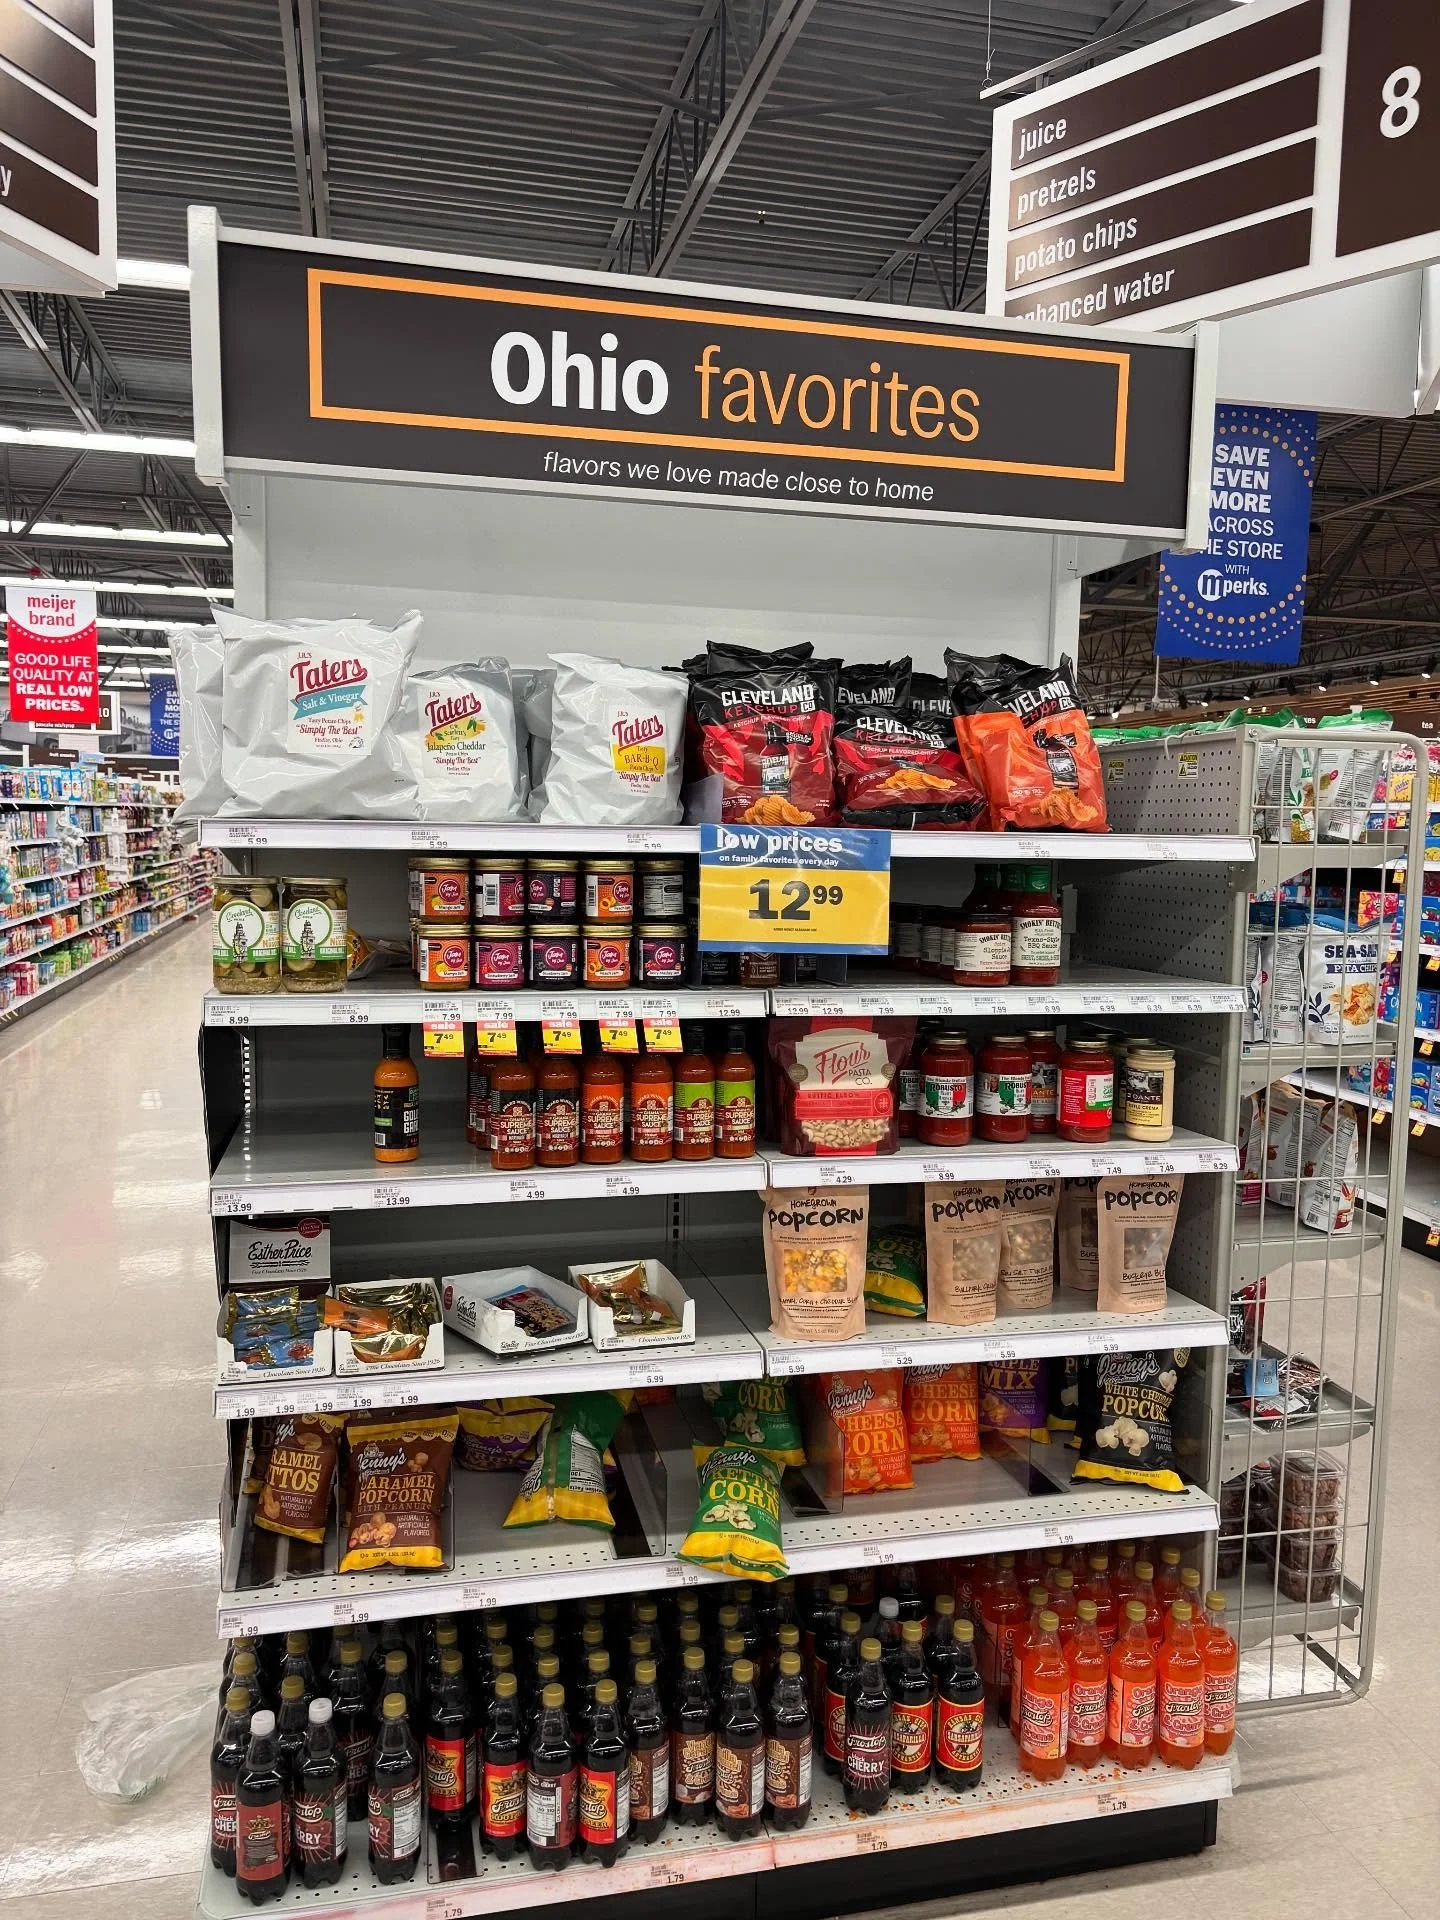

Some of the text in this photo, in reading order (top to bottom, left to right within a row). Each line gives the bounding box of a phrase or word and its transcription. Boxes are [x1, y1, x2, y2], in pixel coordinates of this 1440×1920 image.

[1379, 65, 1421, 139] 8
[1019, 118, 1067, 160] juice
[1017, 167, 1096, 220] pretzels
[1014, 217, 1138, 281] potato chips
[1113, 268, 1175, 306] water
[491, 331, 980, 442] Ohio favorites
[1214, 444, 1270, 467] SAVE
[543, 452, 934, 500] flavors we love made close to home
[1212, 467, 1269, 490] EVEN
[1209, 490, 1271, 513] MORE
[1200, 539, 1284, 560] HE STORE
[1225, 564, 1250, 575] WITH
[27, 595, 76, 612] meijer
[29, 611, 75, 627] brand
[15, 653, 92, 668] GOOD LIFE
[13, 668, 95, 683] QUALITY AT
[290, 658, 368, 694] Taters
[16, 684, 93, 697] REAL LOW
[721, 684, 814, 706] CLEVELAND
[25, 699, 85, 712] PRICES.
[302, 692, 360, 711] Salt & Vinegar
[425, 692, 482, 727] Taters
[724, 703, 798, 719] KETCHUP
[856, 716, 942, 741] CLEVELAND
[1421, 721, 1434, 729] tea
[327, 726, 341, 735] The
[612, 715, 663, 747] Taters
[457, 741, 486, 751] Cheddar
[640, 773, 650, 782] The
[248, 837, 268, 845] 5.99
[429, 840, 448, 849] 5.99
[716, 829, 843, 854] low prices
[732, 854, 758, 863] family
[759, 855, 798, 864] favorites
[799, 858, 823, 866] every
[824, 858, 839, 867] day
[559, 1011, 577, 1019] 7.99
[615, 1010, 633, 1018] 7.99
[659, 1010, 677, 1018] 7.99
[718, 1008, 741, 1017] 12.99
[822, 1007, 844, 1015] 12.99
[937, 1006, 953, 1014] 7.99
[229, 1016, 249, 1024] 8.99
[350, 1015, 369, 1023] 8.99
[442, 1013, 461, 1021] 7.99
[494, 1012, 513, 1020] 7.99
[430, 1022, 456, 1031] sale
[483, 1021, 508, 1030] sale
[549, 1020, 573, 1029] sale
[606, 1019, 629, 1027] sale
[649, 1018, 673, 1027] sale
[813, 1041, 871, 1085] Flour
[848, 1069, 872, 1077] PASTA
[855, 1077, 873, 1085] CO.
[929, 1083, 963, 1092] ROBUSTO
[587, 1115, 619, 1123] SUPREME
[636, 1113, 667, 1122] SUPREME
[725, 1111, 754, 1119] SUPREME
[500, 1119, 532, 1128] SUPREME
[544, 1119, 576, 1127] SUPREME
[1106, 1167, 1122, 1175] 7.49
[1159, 1165, 1175, 1173] 7.49
[1213, 1162, 1228, 1170] 8.29
[526, 1190, 545, 1199] 4.99
[622, 1186, 640, 1195] 4.99
[386, 1196, 410, 1206] 13.99
[790, 1199, 837, 1210] HOMEGROWN
[226, 1203, 252, 1213] 13.99
[932, 1195, 1000, 1222] POPCORN
[768, 1207, 864, 1232] POPCORN
[248, 1238, 312, 1261] Esther Price
[380, 1361, 411, 1370] Chocolates
[427, 1358, 441, 1366] 1926
[789, 1365, 805, 1373] 5.99
[263, 1369, 295, 1378] Chocolates
[310, 1366, 326, 1374] 1926
[1097, 1351, 1160, 1388] Jenny's
[980, 1367, 1037, 1390] MIX
[911, 1383, 977, 1399] CHEESE
[1104, 1381, 1141, 1397] WHITE
[400, 1396, 419, 1404] 1.99
[738, 1381, 786, 1413] CORN
[827, 1379, 876, 1411] Jenny's
[314, 1402, 333, 1412] 1.99
[353, 1399, 372, 1408] 1.99
[236, 1408, 255, 1417] 1.99
[276, 1405, 295, 1414] 1.99
[911, 1400, 977, 1422] CORN
[836, 1410, 903, 1431] CHEESE
[845, 1427, 905, 1456] CORN
[357, 1447, 408, 1472] Jenny's
[701, 1450, 758, 1485] Jenny's
[711, 1466, 780, 1499] KETTLE
[359, 1489, 434, 1506] POPCORN
[709, 1480, 779, 1520] CORN
[397, 1514, 423, 1523] NATURALLY
[397, 1522, 430, 1530] ARTIFICIALLY
[1059, 1535, 1074, 1543] 1.99
[879, 1554, 894, 1563] 1.99
[682, 1576, 699, 1585] 1.99
[479, 1598, 497, 1607] 1.99
[351, 1613, 369, 1622] 1.99
[239, 1626, 259, 1636] 1.99
[1164, 1683, 1202, 1699] Orange
[1165, 1699, 1202, 1717] Frostop
[947, 1714, 973, 1727] KANSAS
[847, 1733, 887, 1752] Frostop
[851, 1752, 865, 1761] black
[847, 1756, 885, 1773] CHERRY
[1112, 1801, 1127, 1810] 1.79
[872, 1841, 888, 1850] 1.79
[667, 1874, 684, 1883] 1.79
[444, 1908, 463, 1918] 1.79
